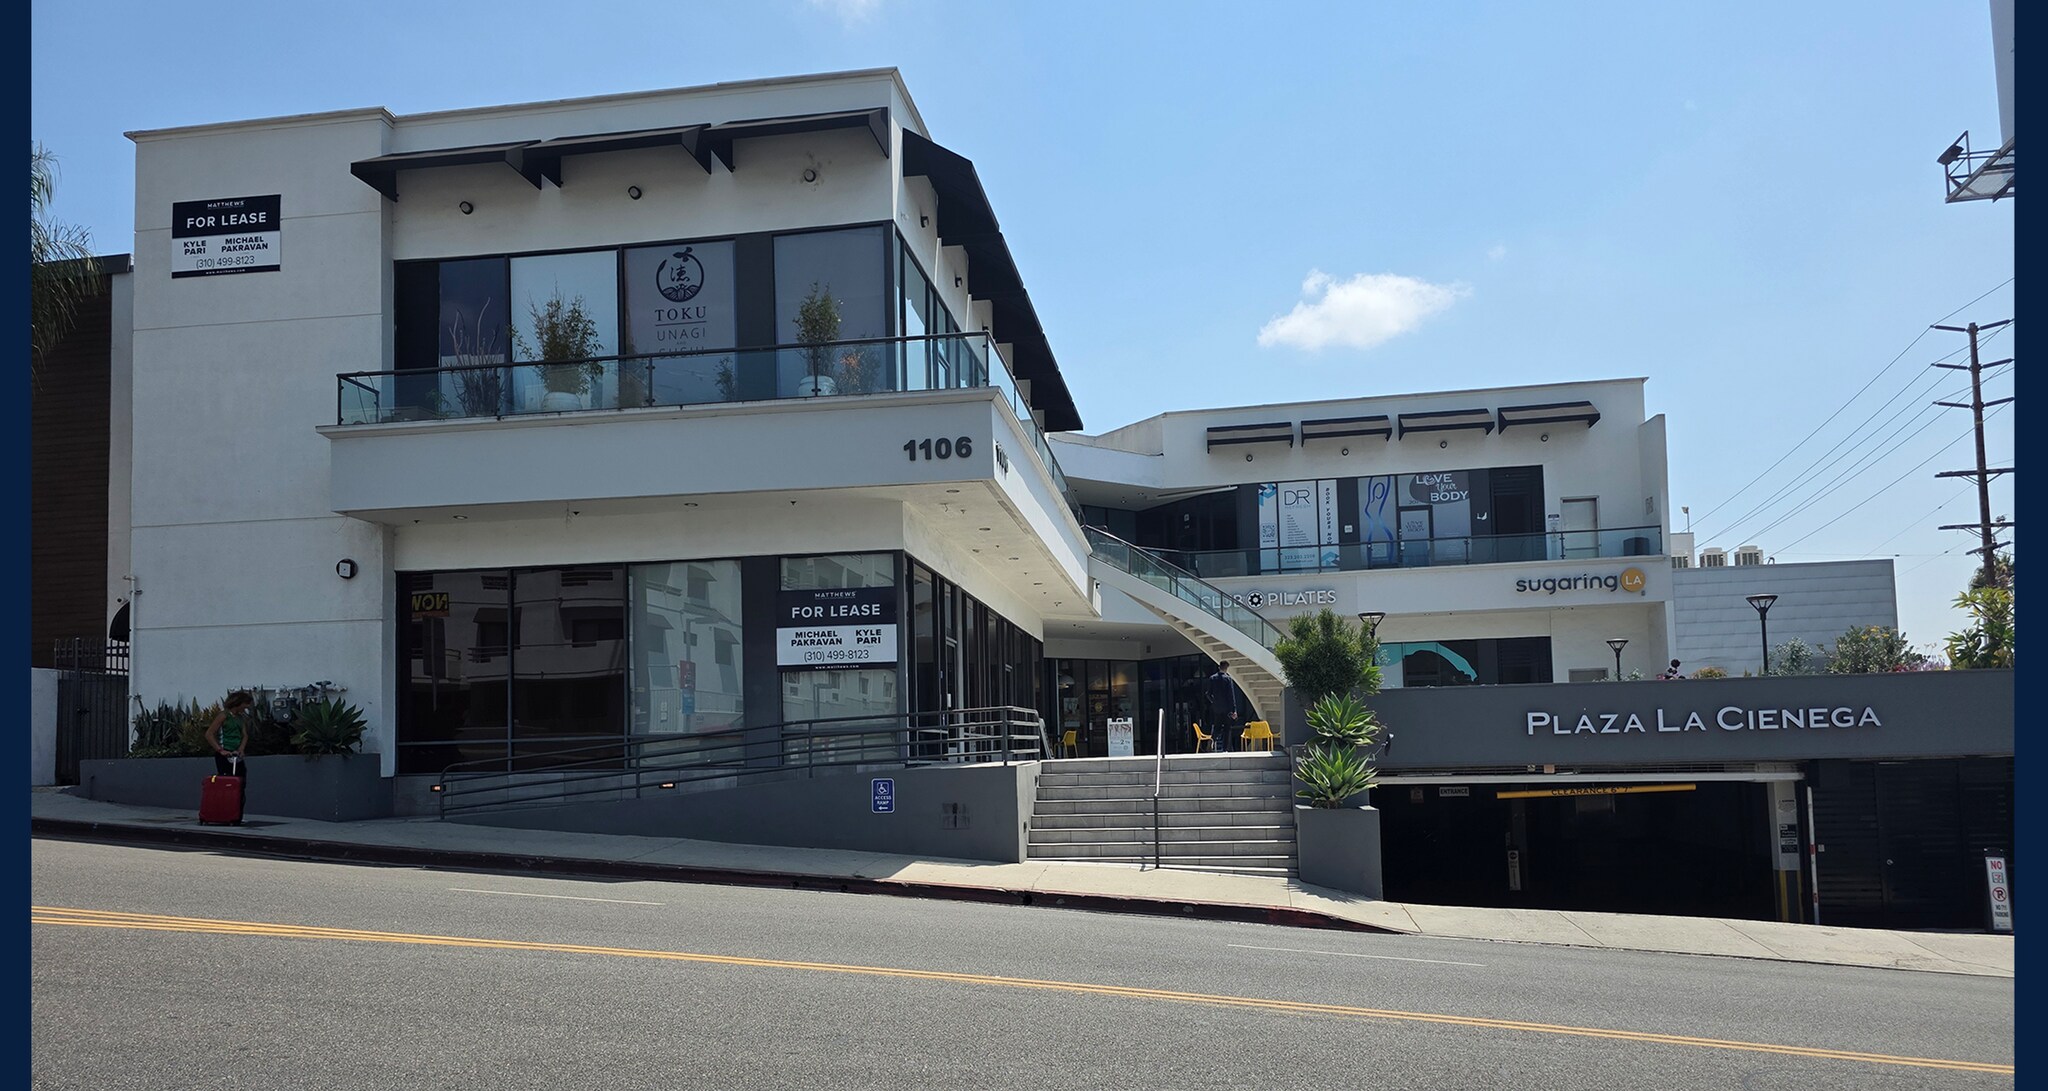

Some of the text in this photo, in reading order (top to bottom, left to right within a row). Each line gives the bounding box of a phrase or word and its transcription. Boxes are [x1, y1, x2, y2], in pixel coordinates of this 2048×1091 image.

[187, 212, 267, 228] FOR LEASE
[184, 240, 206, 248] KYLE
[225, 236, 264, 245] MICHAEL
[184, 247, 206, 255] PARI
[221, 243, 268, 252] PAKRAVAN
[196, 256, 255, 269] (310) 499-8123
[655, 306, 706, 321] TOKU
[657, 327, 706, 341] UNAGI
[903, 436, 972, 461] 1106
[1416, 473, 1452, 485] LOVE
[1284, 490, 1310, 505] DR
[1430, 490, 1468, 502] BODY
[1516, 574, 1641, 595] sugaring LA
[1268, 590, 1336, 606] PILATES
[792, 604, 880, 619] FOR LEASE
[795, 630, 838, 638] MICHAEL
[791, 638, 842, 647] PAKRAVAN
[804, 649, 869, 662] (310) 499-8123
[1551, 787, 1608, 796] CLEARANCE
[1990, 860, 2002, 870] NO
